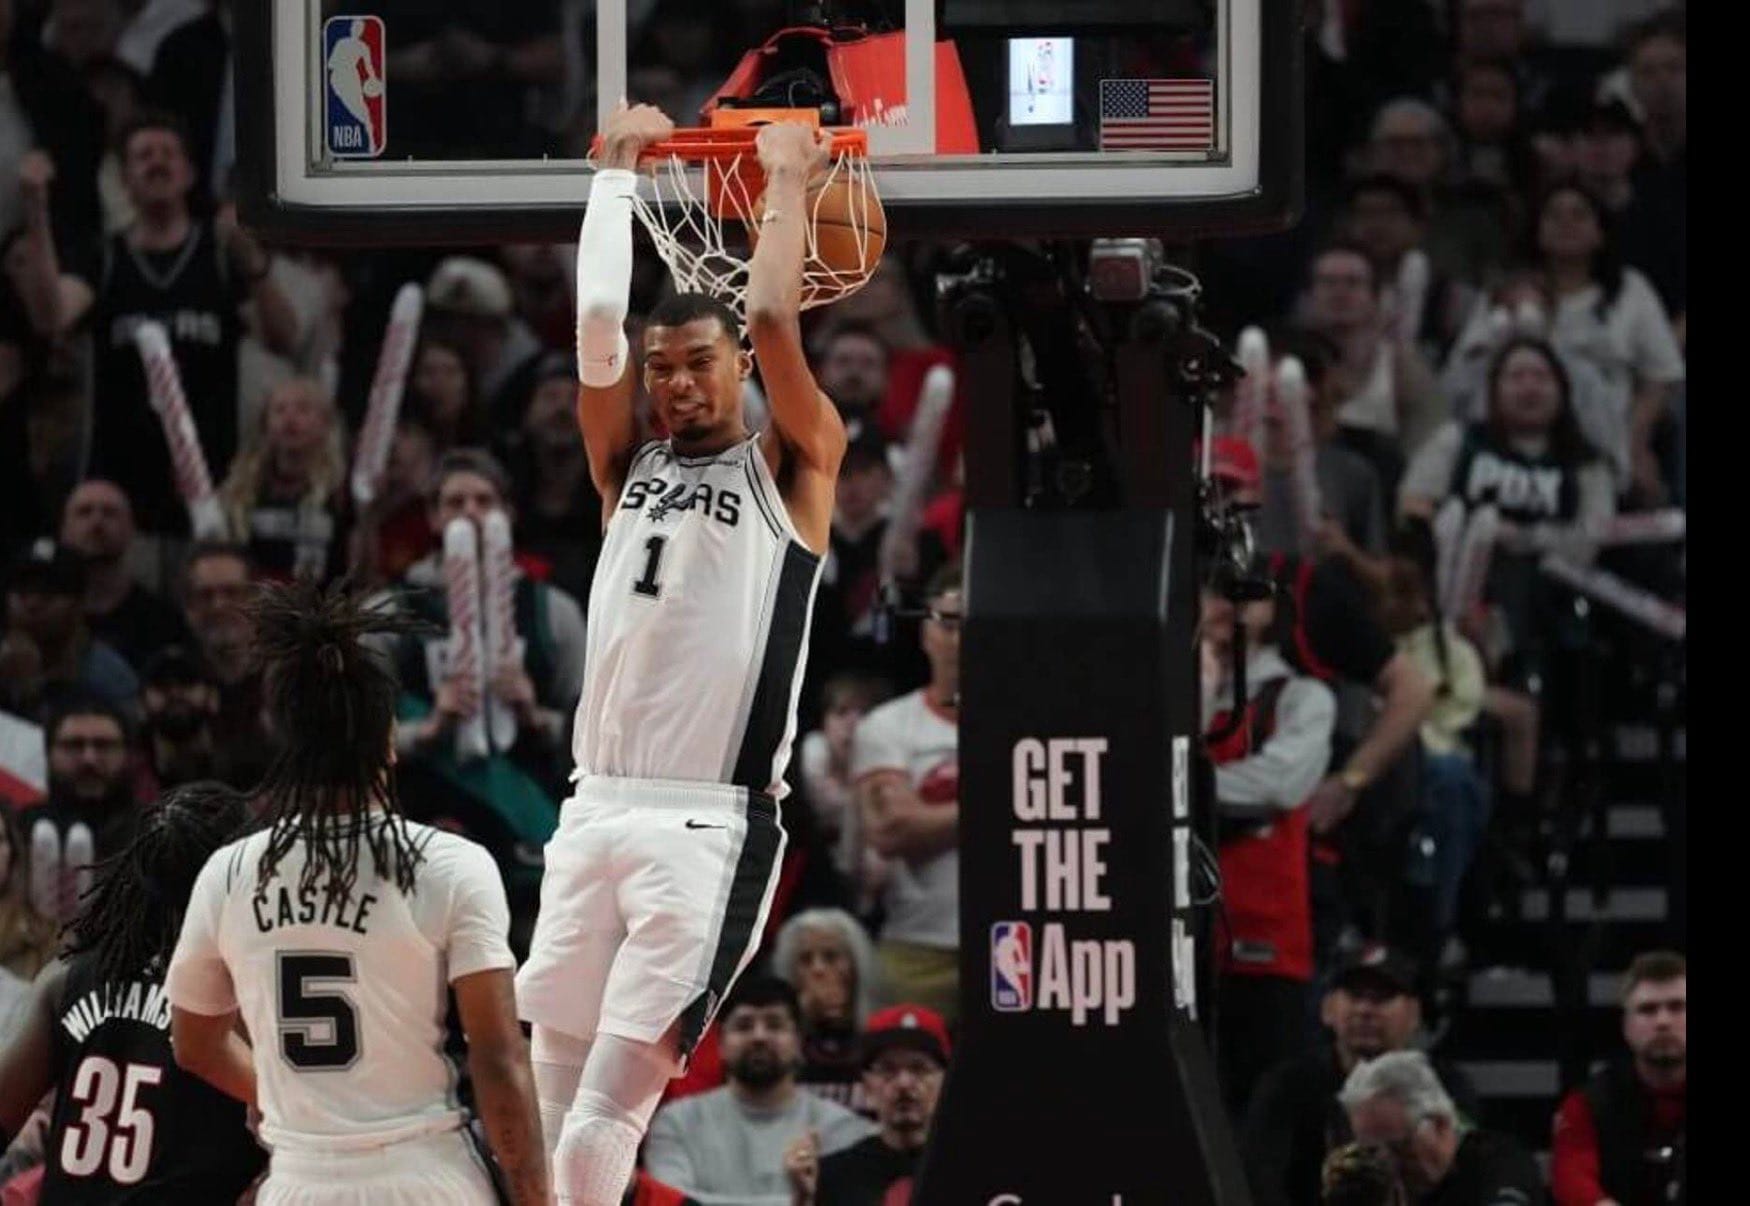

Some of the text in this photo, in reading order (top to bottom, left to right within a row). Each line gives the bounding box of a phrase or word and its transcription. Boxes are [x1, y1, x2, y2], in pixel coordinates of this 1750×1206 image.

[333, 126, 362, 147] NBA
[633, 536, 665, 596] 1
[1013, 738, 1108, 821] GET
[254, 887, 378, 934] CASTLE
[1012, 829, 1111, 911] THE
[62, 981, 171, 1043] WILLIAMS
[276, 951, 364, 1073] 5
[1038, 923, 1136, 1026] App
[61, 1056, 162, 1185] 35
